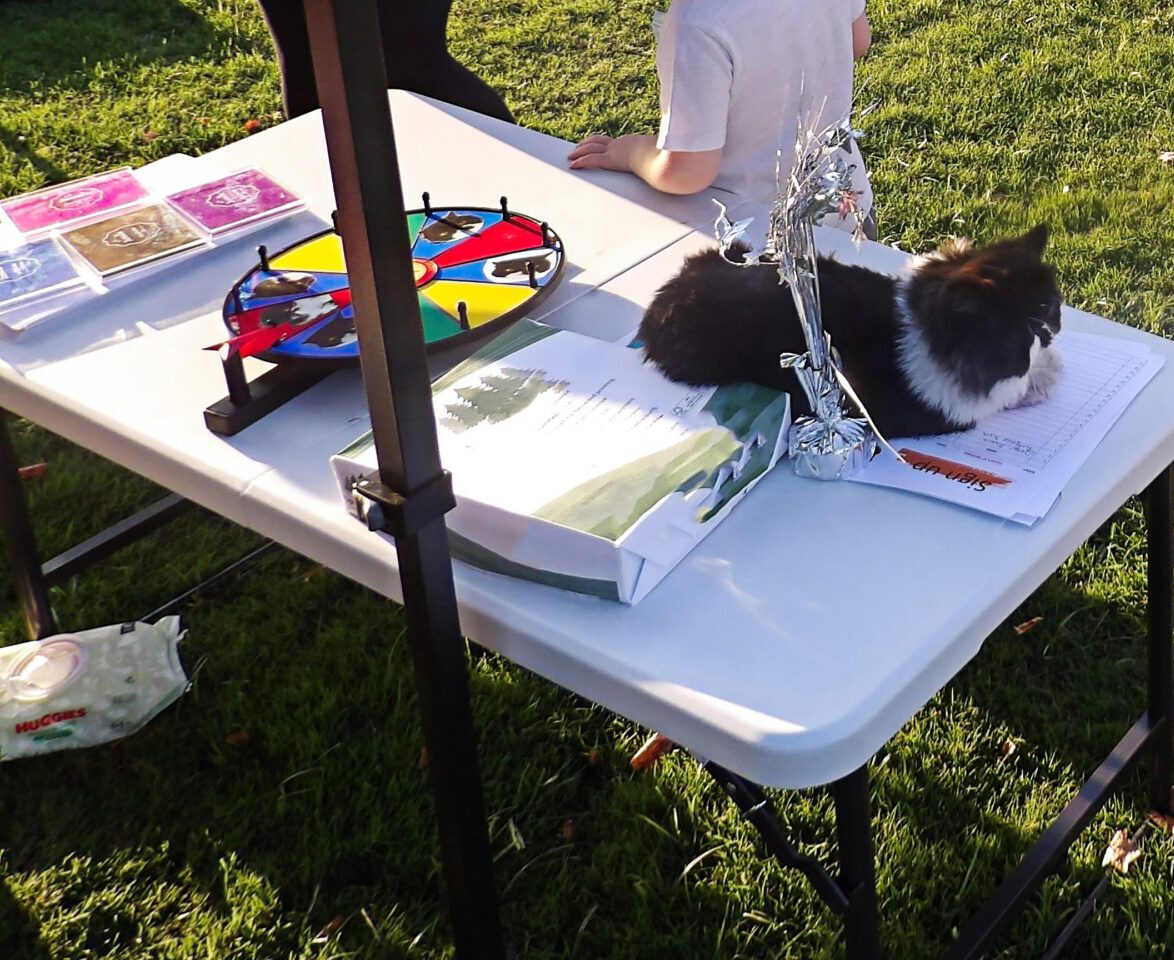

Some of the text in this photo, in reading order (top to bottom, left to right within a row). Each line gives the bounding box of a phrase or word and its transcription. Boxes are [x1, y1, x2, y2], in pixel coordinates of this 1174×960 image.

[912, 461, 992, 492] Sign up
[15, 707, 88, 734] HUGGIES
